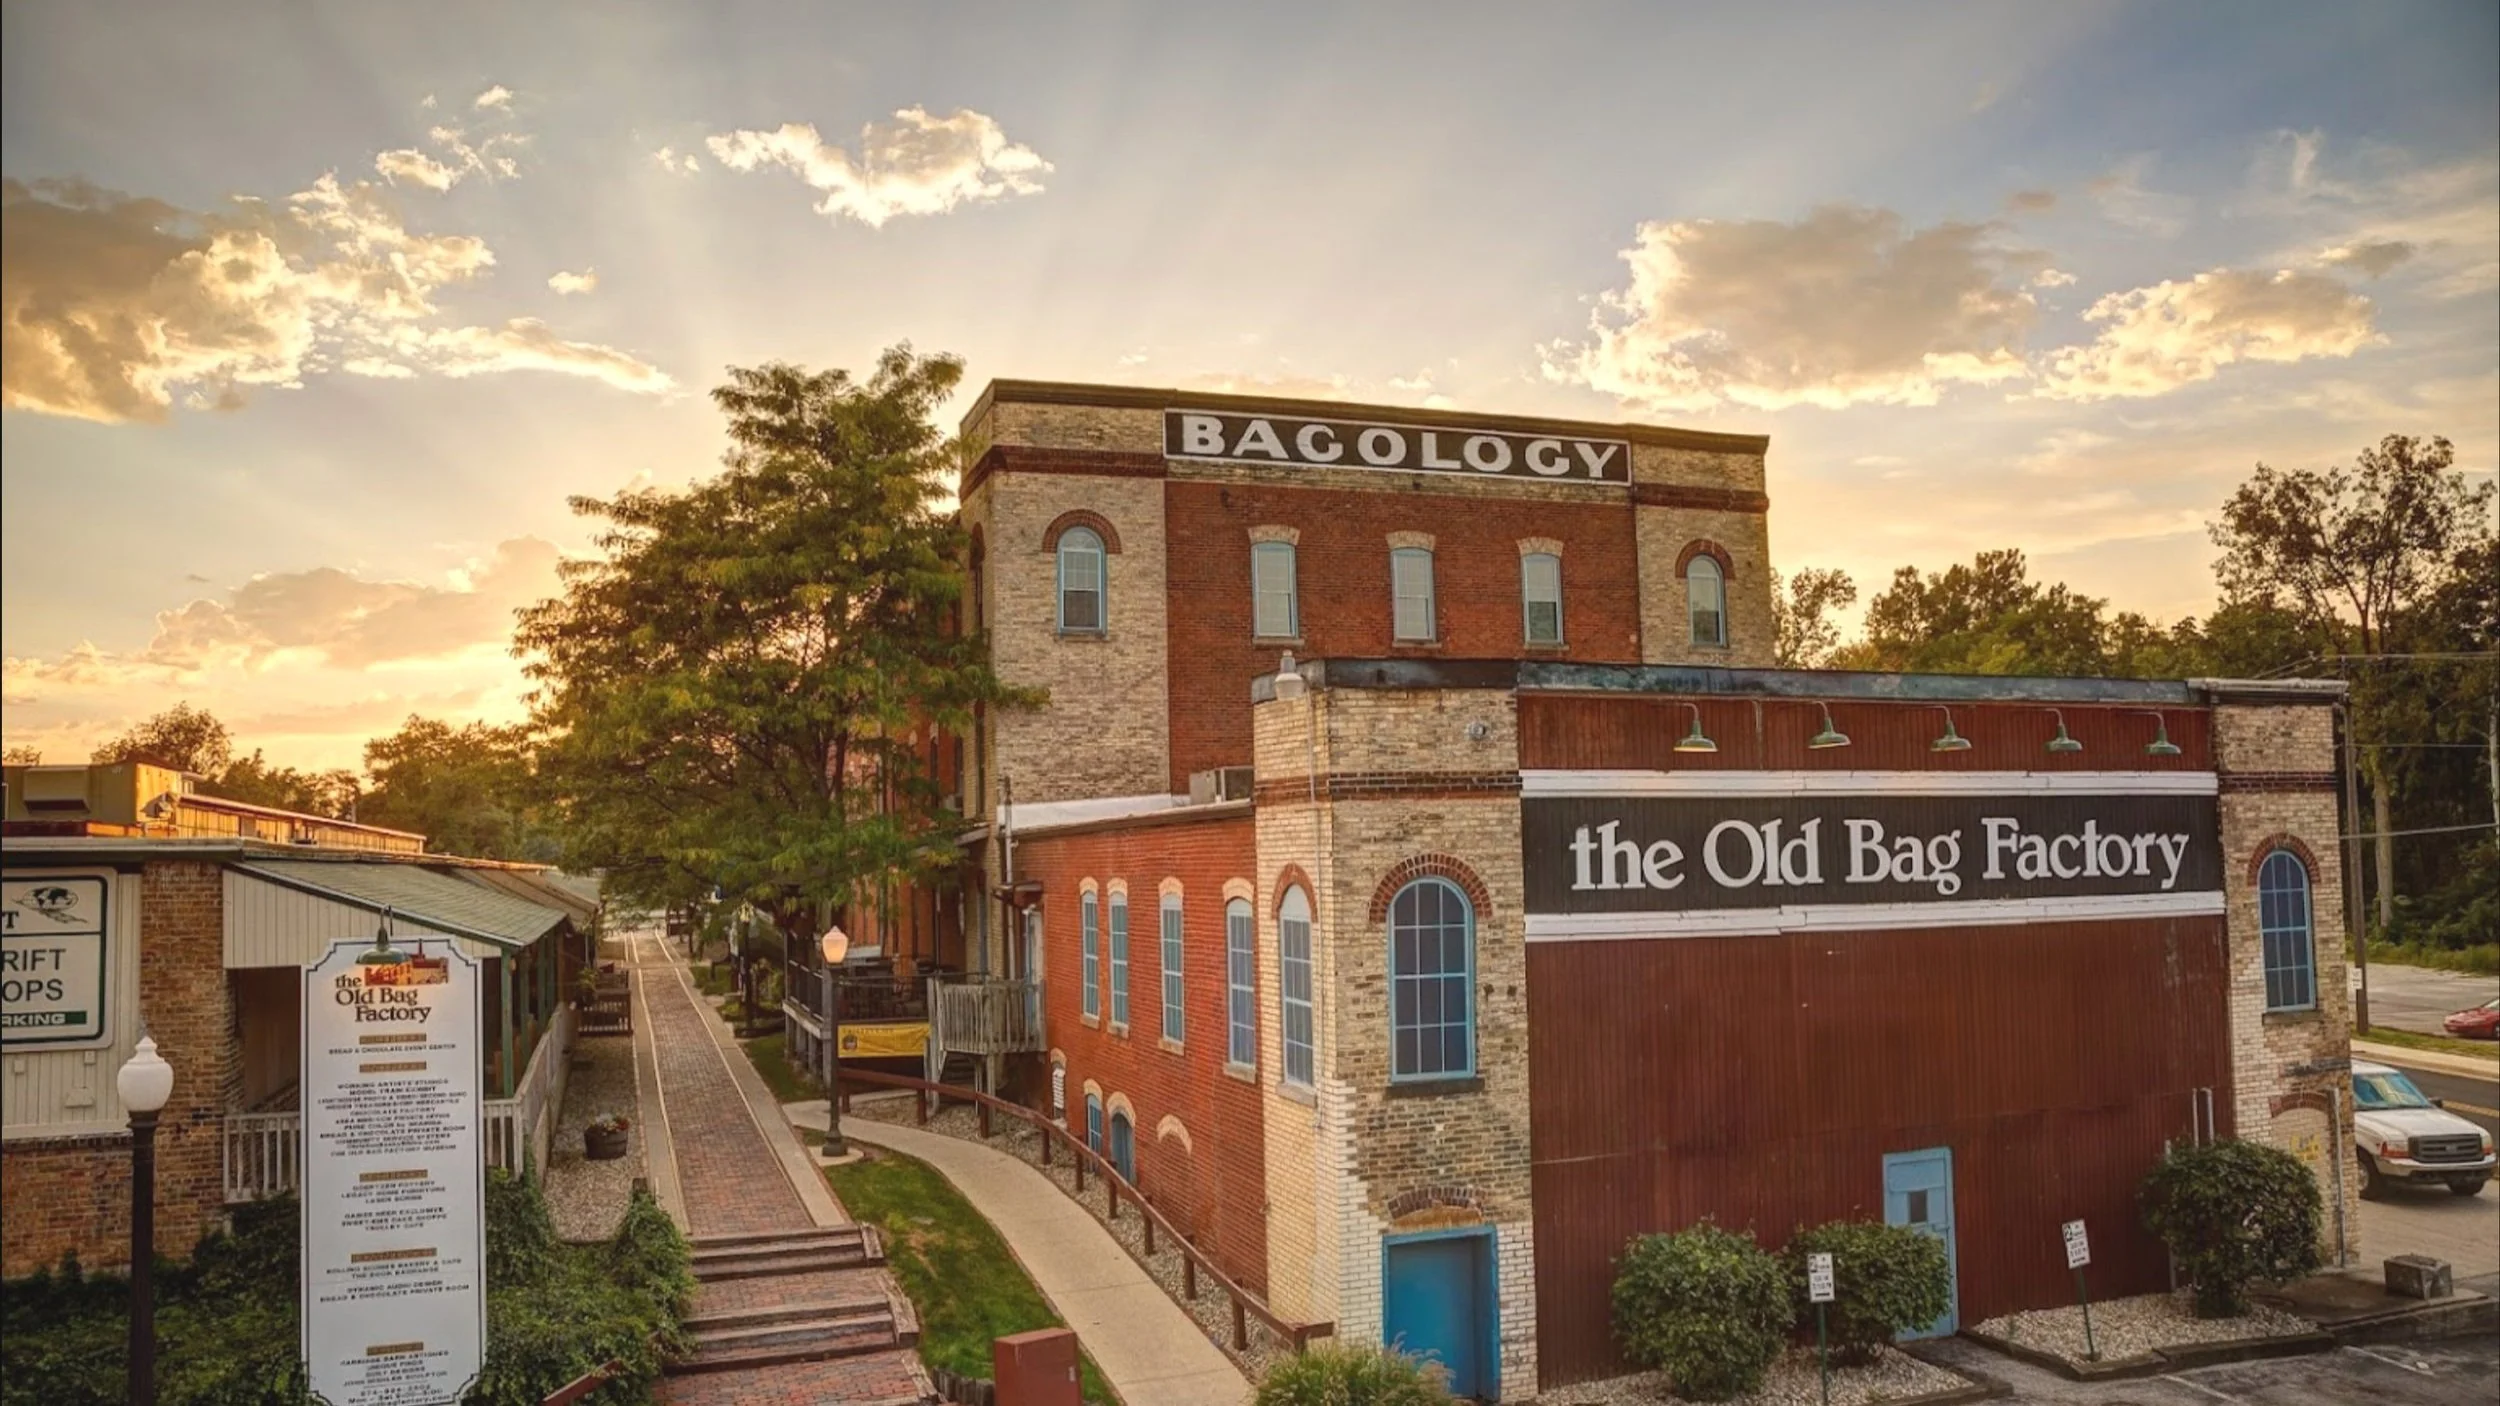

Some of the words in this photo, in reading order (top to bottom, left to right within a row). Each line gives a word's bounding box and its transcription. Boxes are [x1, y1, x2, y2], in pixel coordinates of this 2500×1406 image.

[1181, 414, 1618, 478] BAGOLOGY
[1570, 819, 1684, 890] the
[1703, 817, 1825, 888] Old
[1844, 819, 1961, 894] Bag
[1981, 816, 2189, 889] Factory
[334, 974, 362, 988] the
[335, 987, 374, 1006] Old
[380, 988, 418, 1006] Bag
[355, 1006, 432, 1023] Factory
